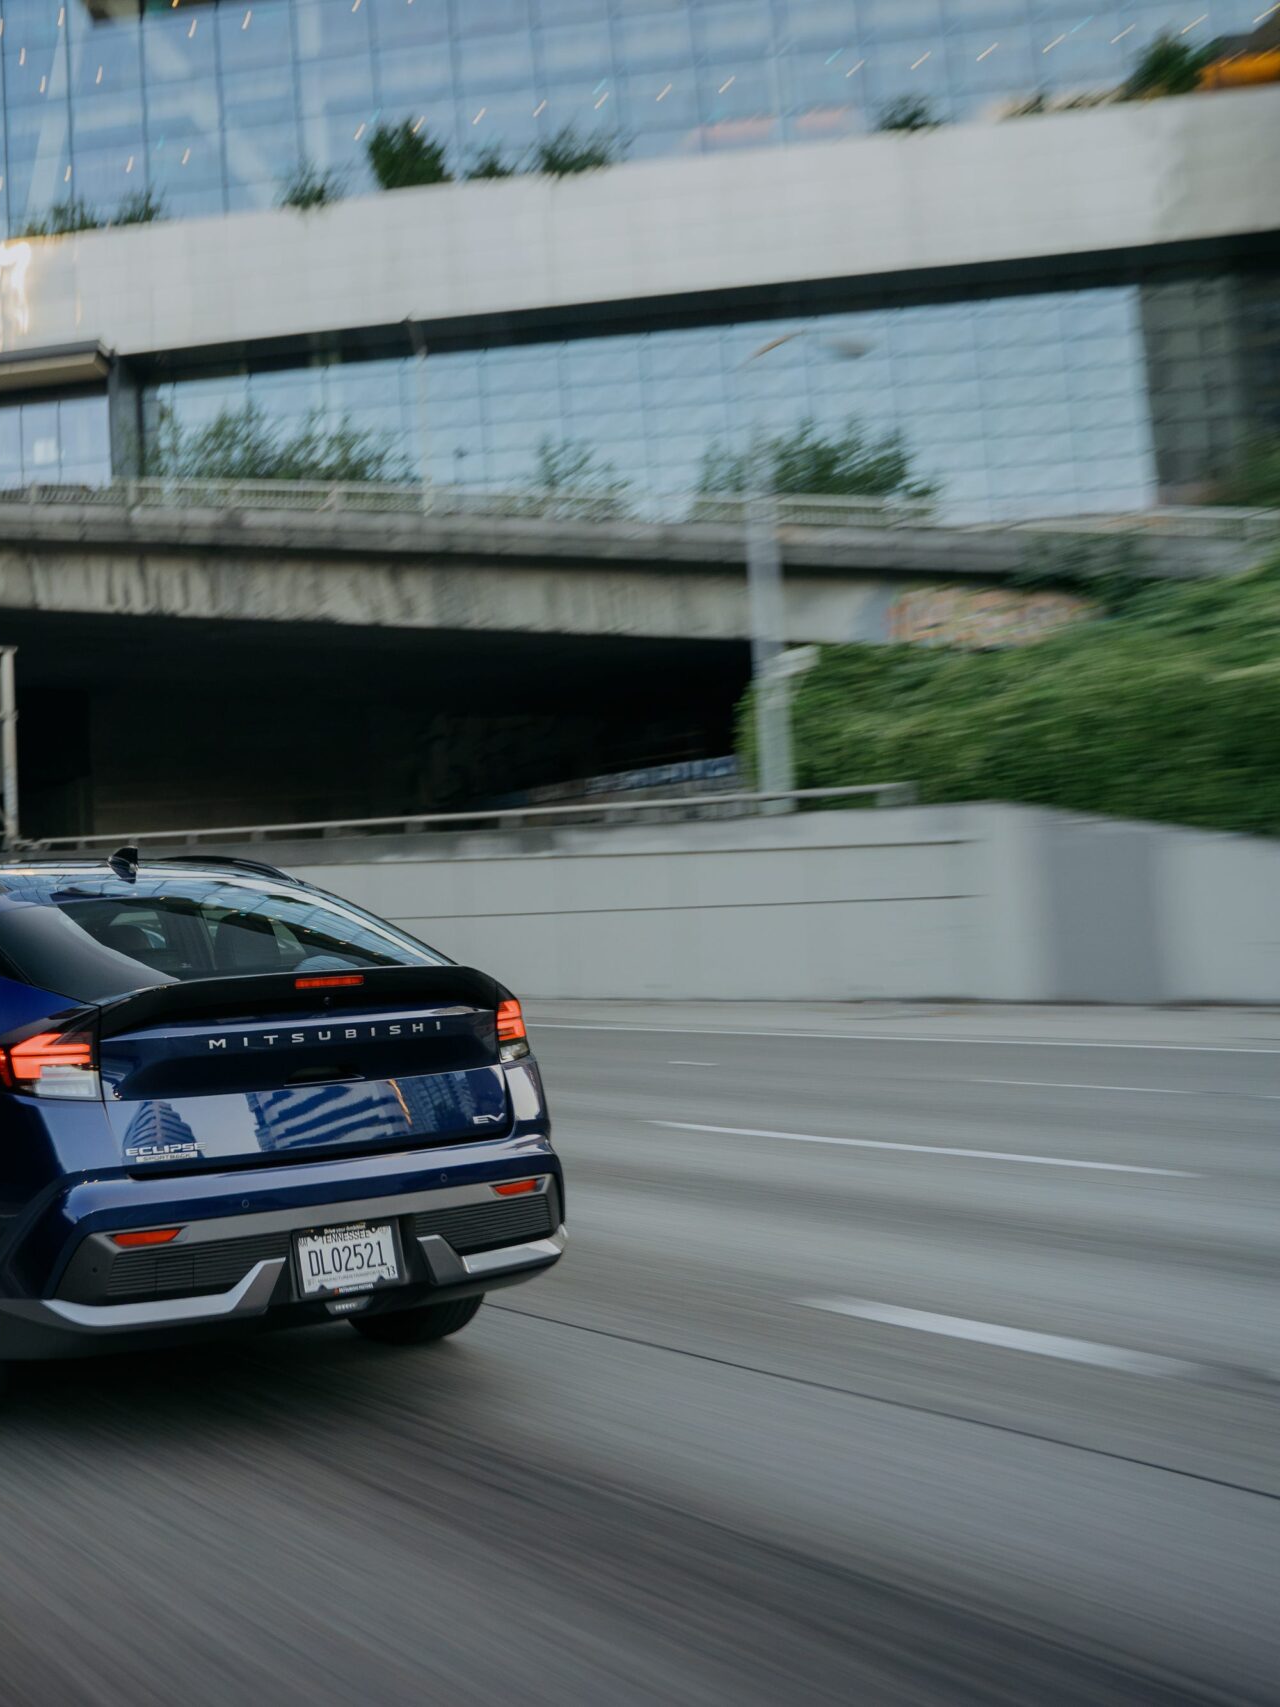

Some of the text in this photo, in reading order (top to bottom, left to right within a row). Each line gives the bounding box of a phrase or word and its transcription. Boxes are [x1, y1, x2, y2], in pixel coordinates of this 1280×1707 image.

[208, 1020, 443, 1050] MITSUBISHI
[472, 1112, 505, 1125] EV
[125, 1142, 208, 1157] ECLIPSE
[308, 1241, 387, 1277] DL02521
